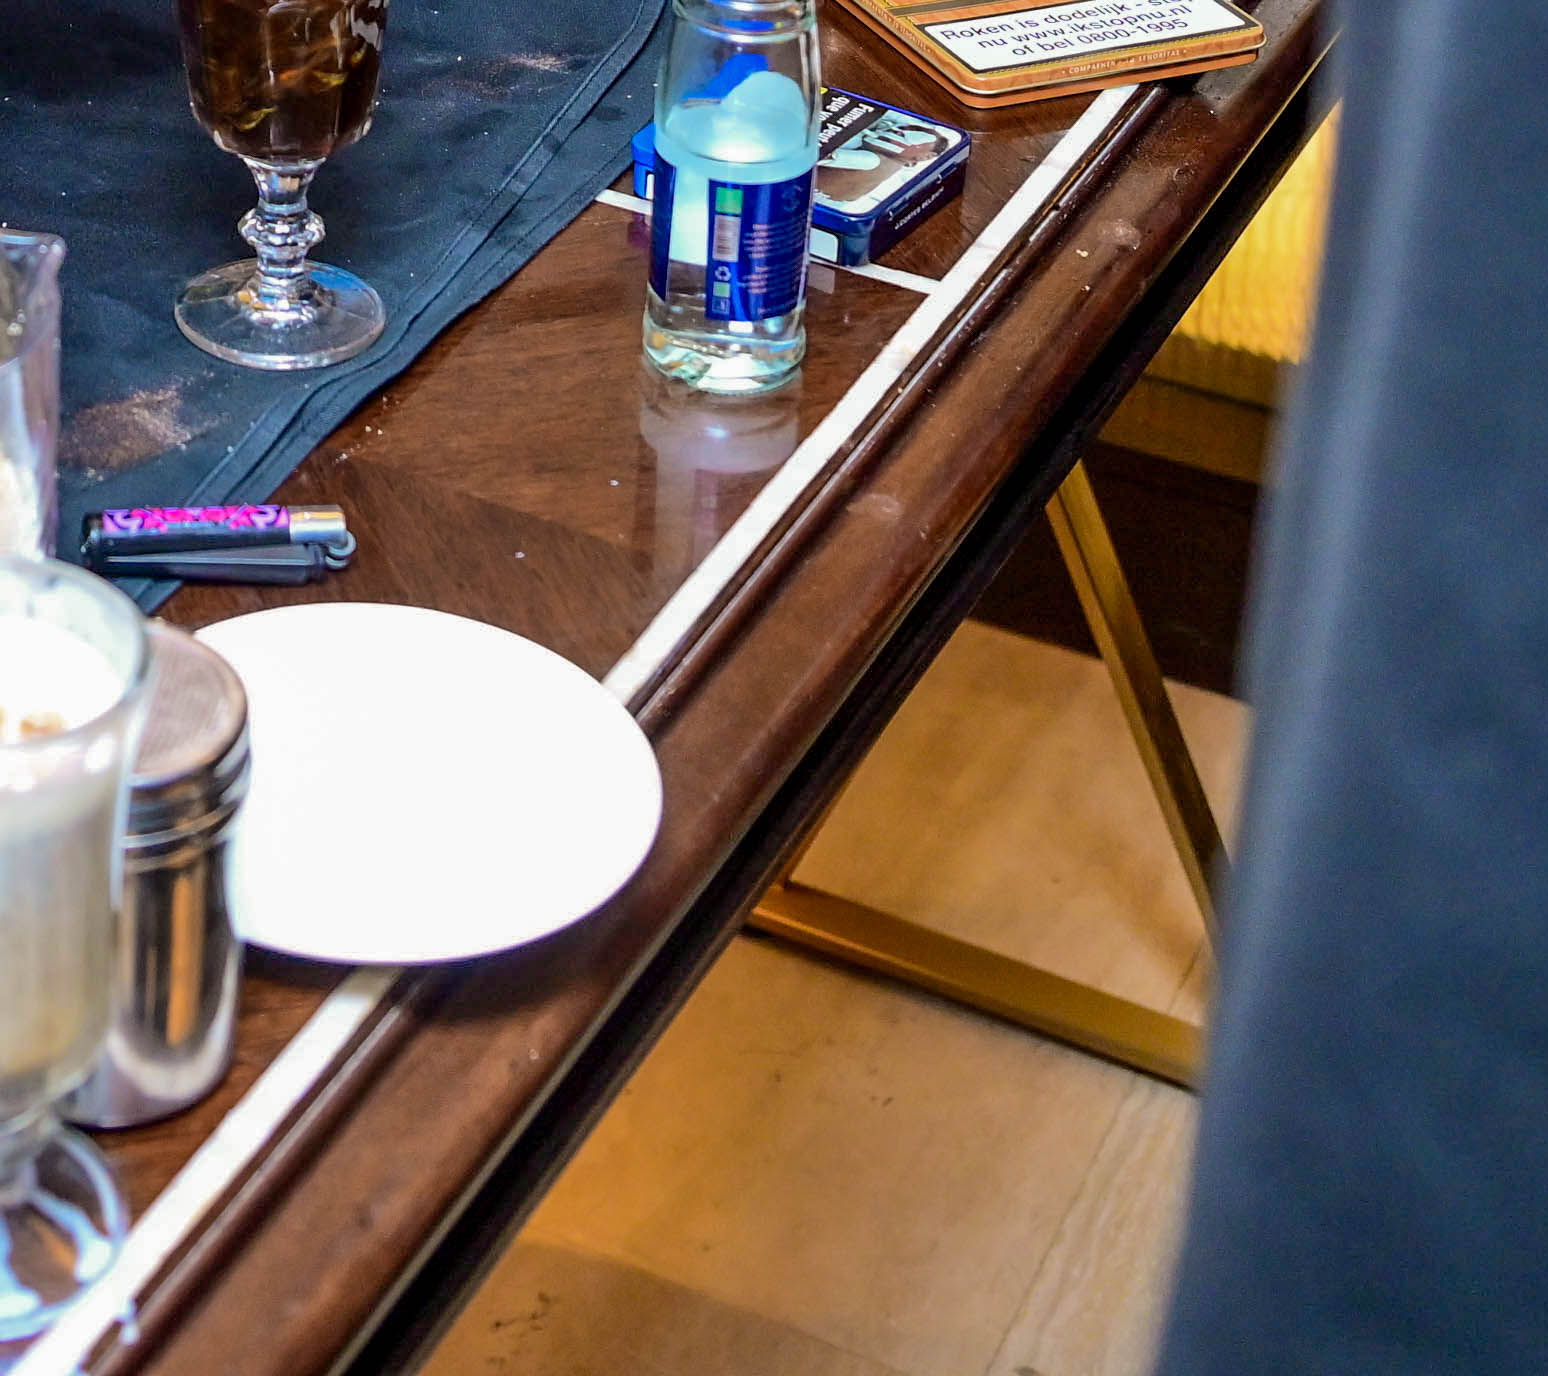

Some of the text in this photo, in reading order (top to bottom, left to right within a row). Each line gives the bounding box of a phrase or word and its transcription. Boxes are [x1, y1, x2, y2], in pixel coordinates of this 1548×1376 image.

[940, 22, 1013, 41] Roken
[1020, 19, 1039, 29] is
[1044, 3, 1129, 26] dodelijk
[977, 5, 1193, 49] nu www.ikstopnu.nl
[1012, 19, 1189, 57] of bel 0800-1995
